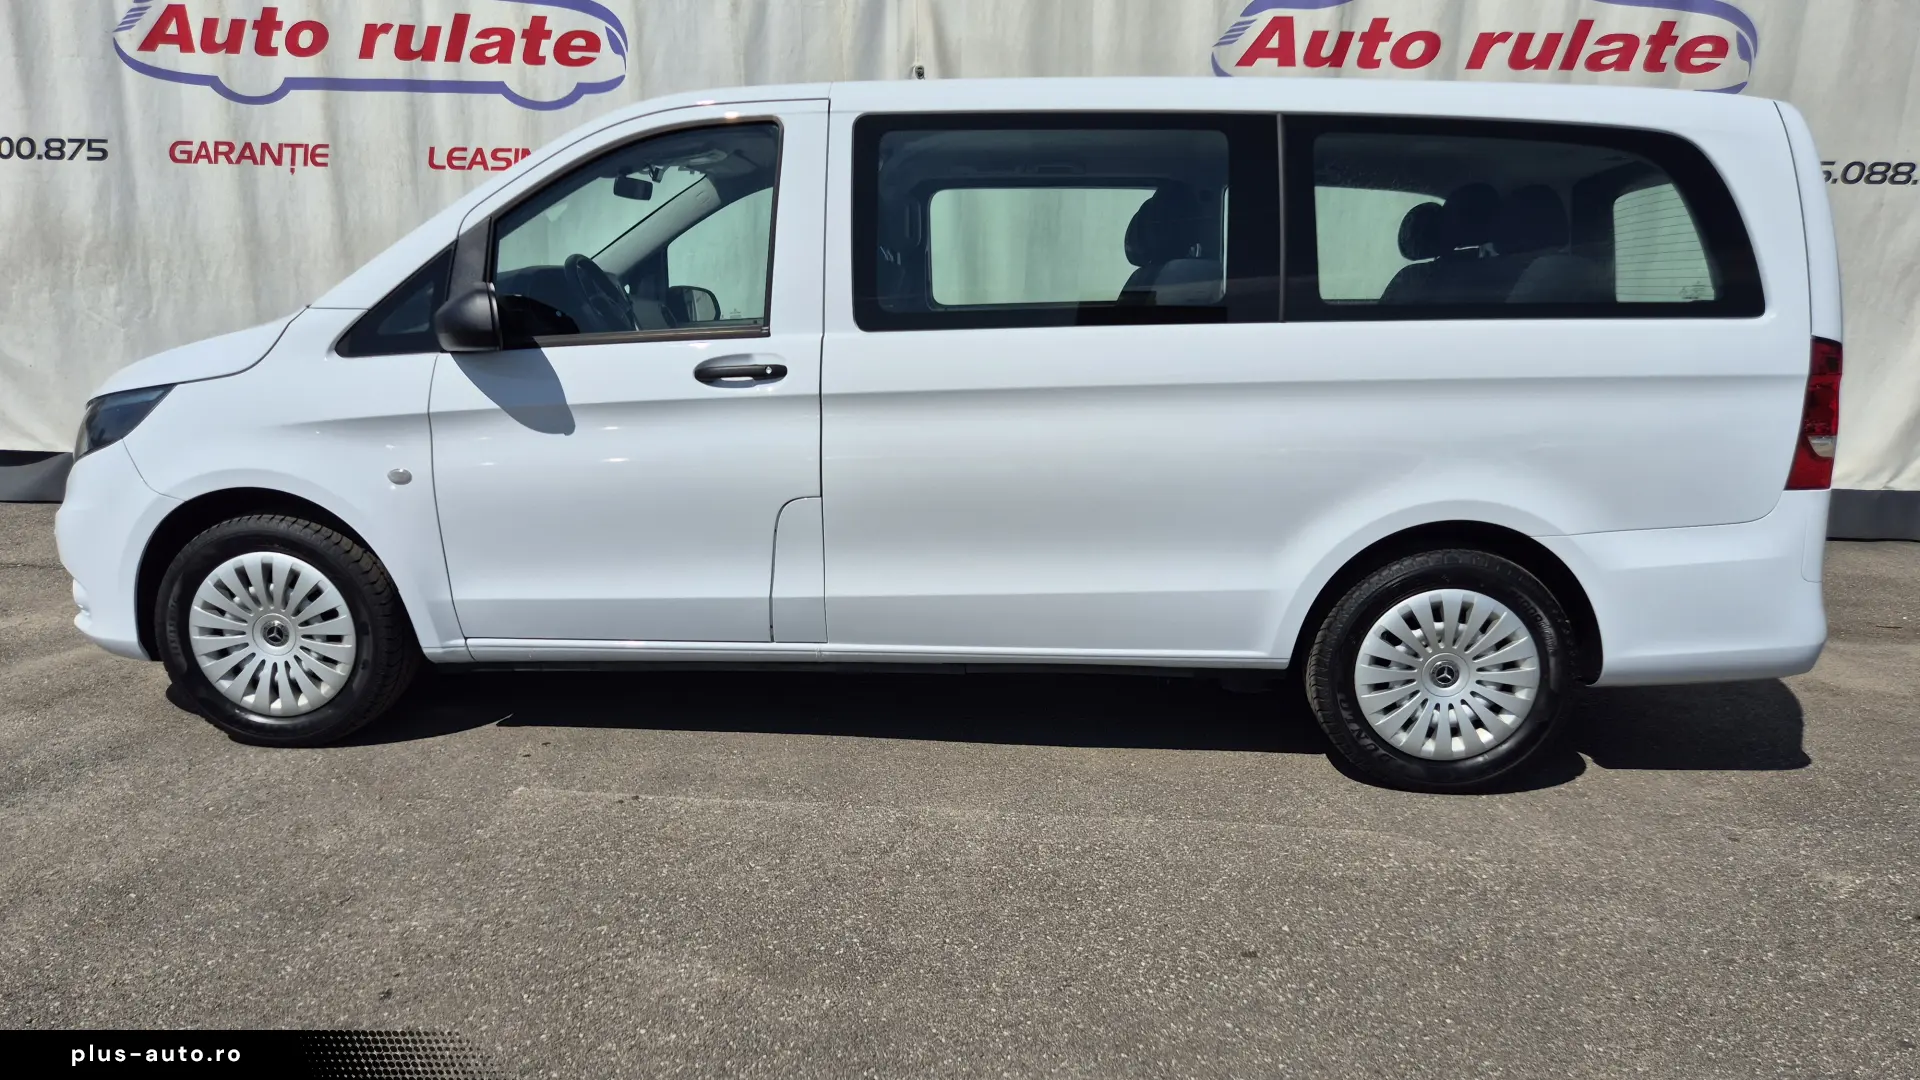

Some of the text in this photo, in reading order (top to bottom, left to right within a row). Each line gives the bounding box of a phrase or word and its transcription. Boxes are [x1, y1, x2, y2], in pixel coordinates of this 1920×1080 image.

[138, 3, 602, 68] Auto rulate
[1236, 15, 1730, 75] Auto rulate
[0, 136, 109, 162] 00.875
[169, 140, 329, 175] GARANȚIE
